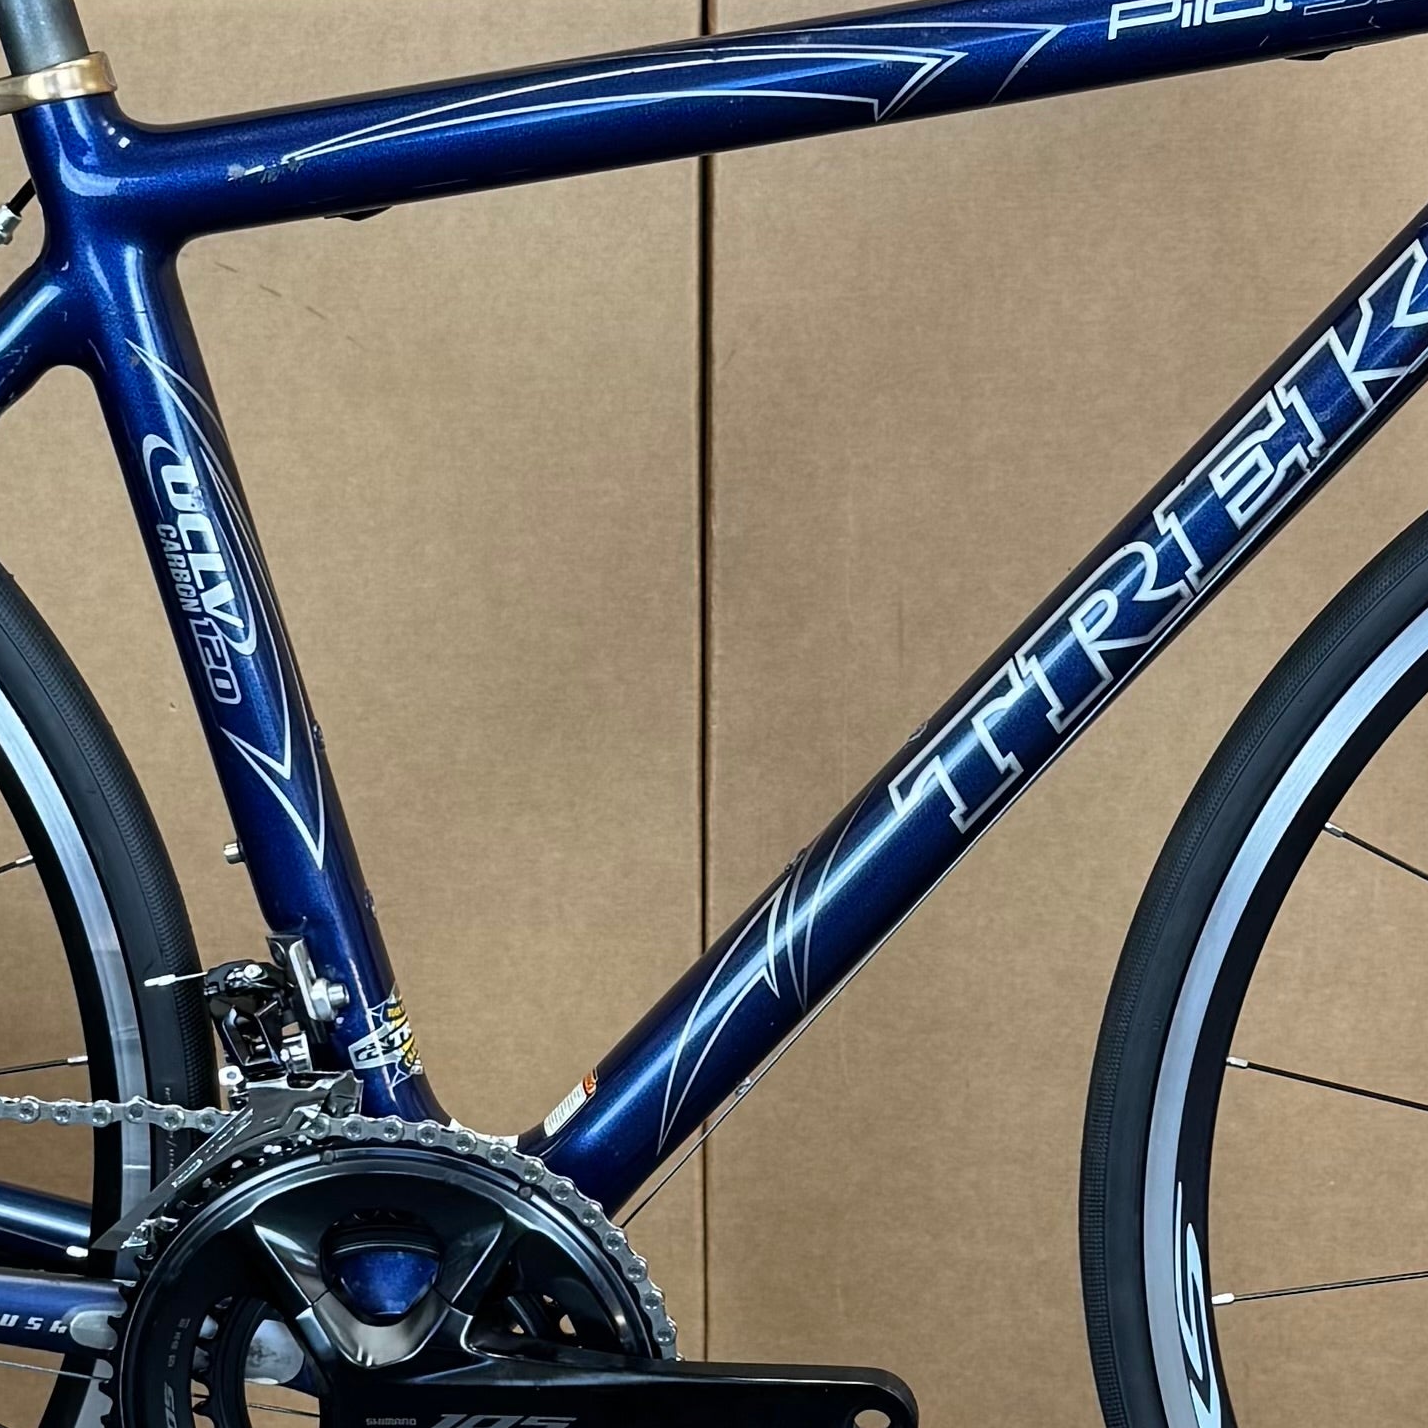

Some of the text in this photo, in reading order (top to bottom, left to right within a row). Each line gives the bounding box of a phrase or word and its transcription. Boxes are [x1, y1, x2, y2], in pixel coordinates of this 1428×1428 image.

[156, 523, 241, 705] CARBON 120
[365, 1417, 417, 1427] SHIMANO
